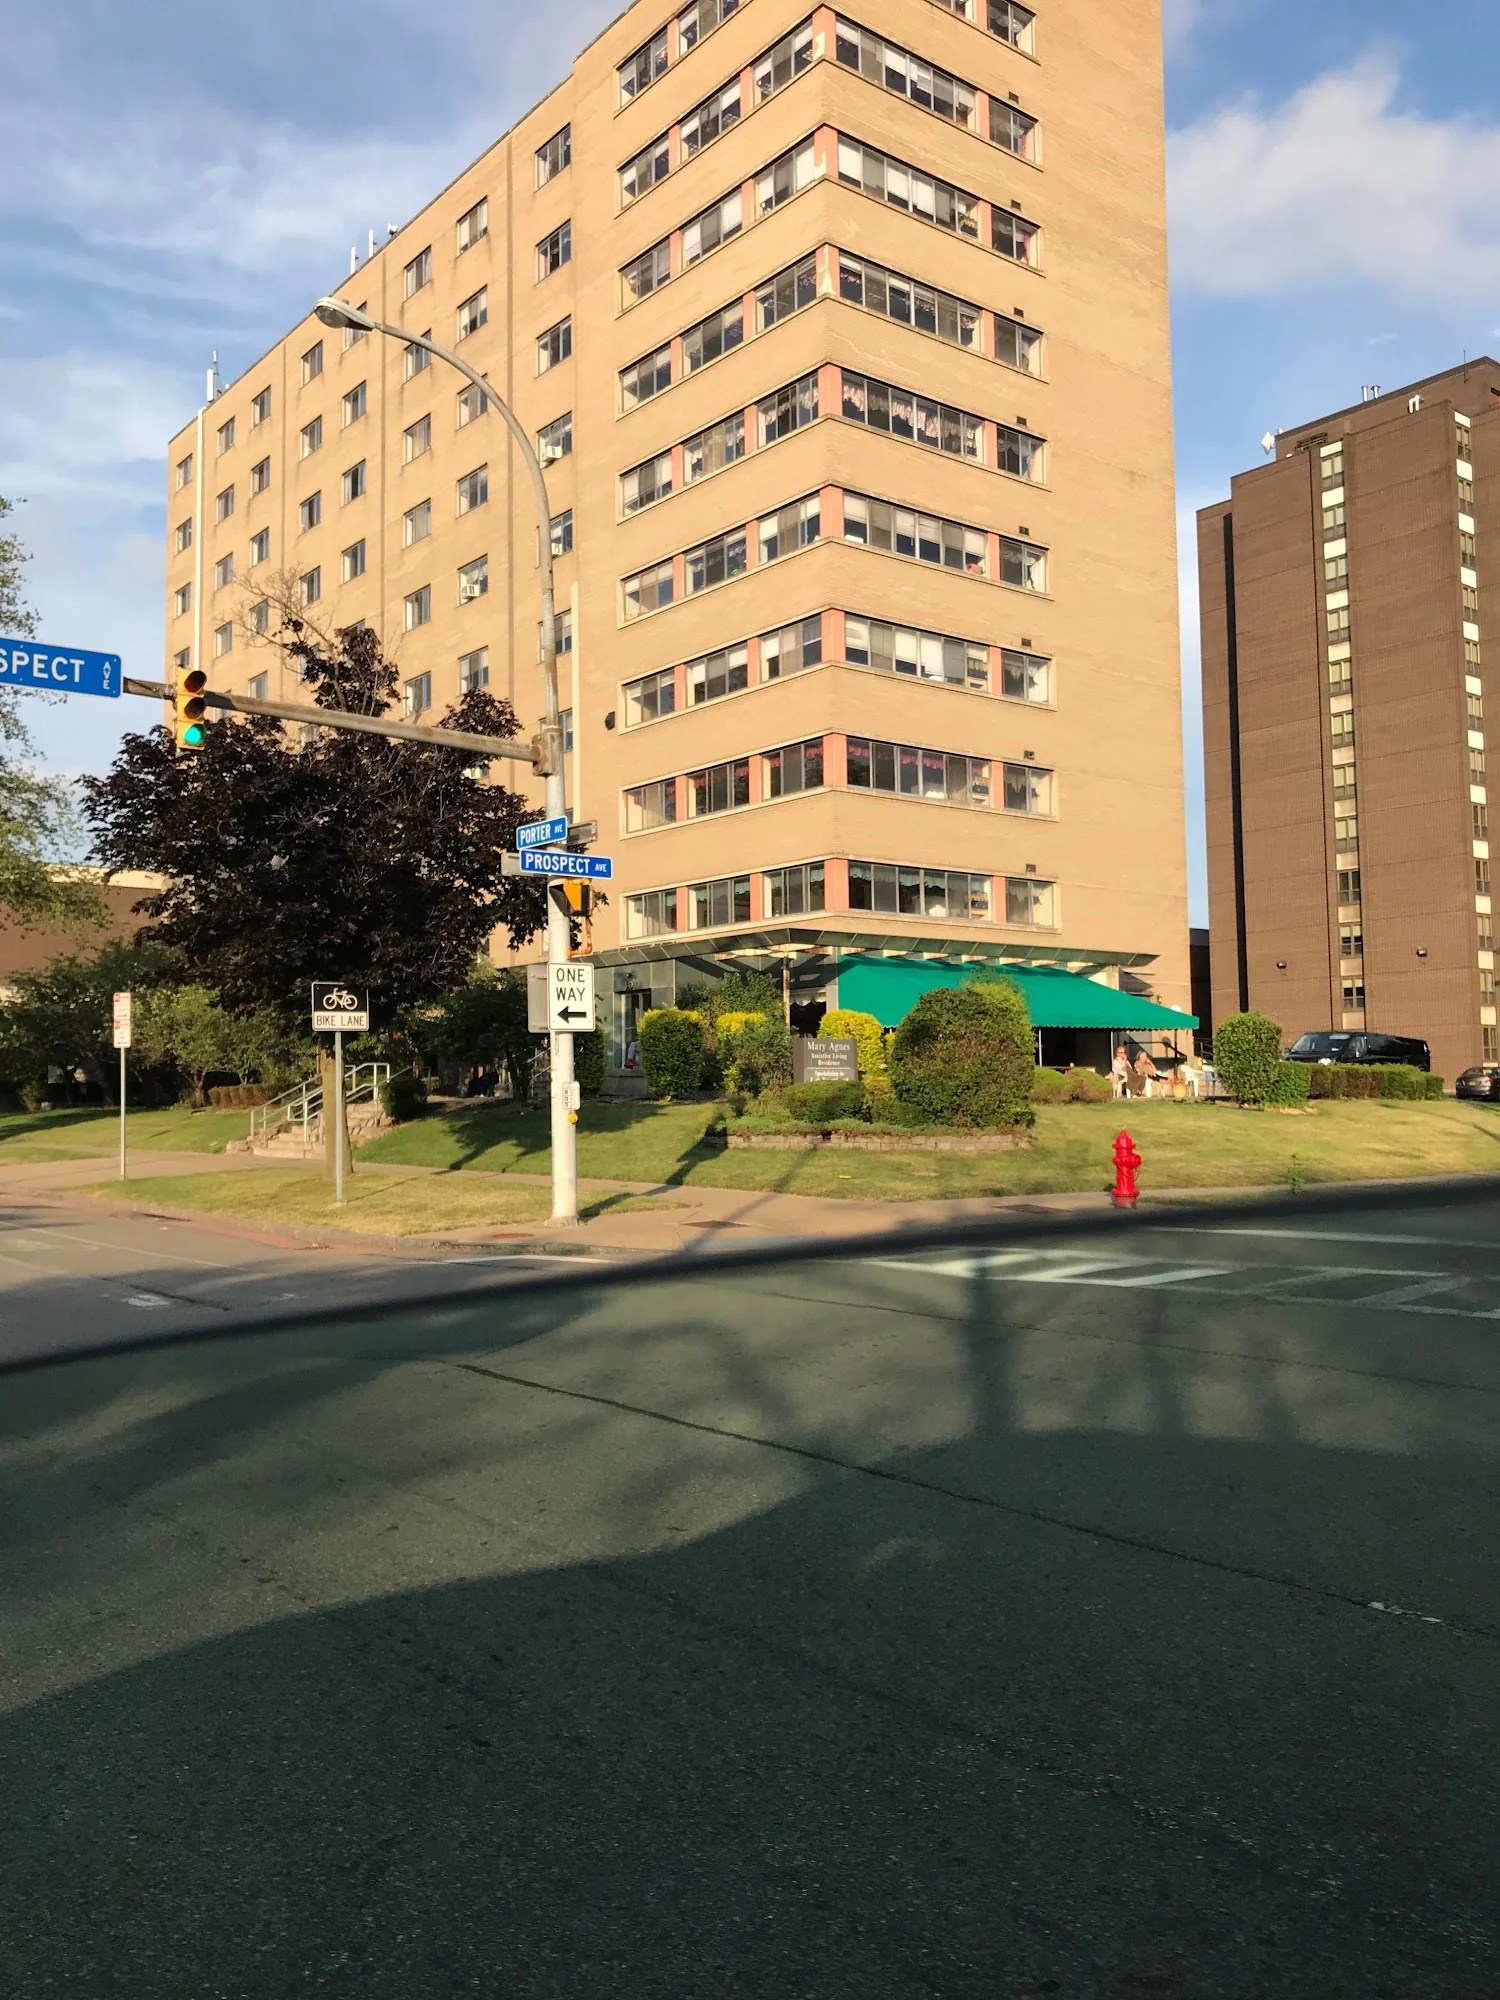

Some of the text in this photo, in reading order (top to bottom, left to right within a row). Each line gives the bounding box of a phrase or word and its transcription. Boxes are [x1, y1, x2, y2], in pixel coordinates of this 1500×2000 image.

[520, 823, 563, 846] PORTER AVE
[525, 852, 607, 874] PROSPECT AVE
[556, 968, 585, 983] ONE
[556, 987, 586, 1002] WAY
[316, 1015, 365, 1027] BIKE LANE
[807, 1041, 851, 1052] Mary Agnes
